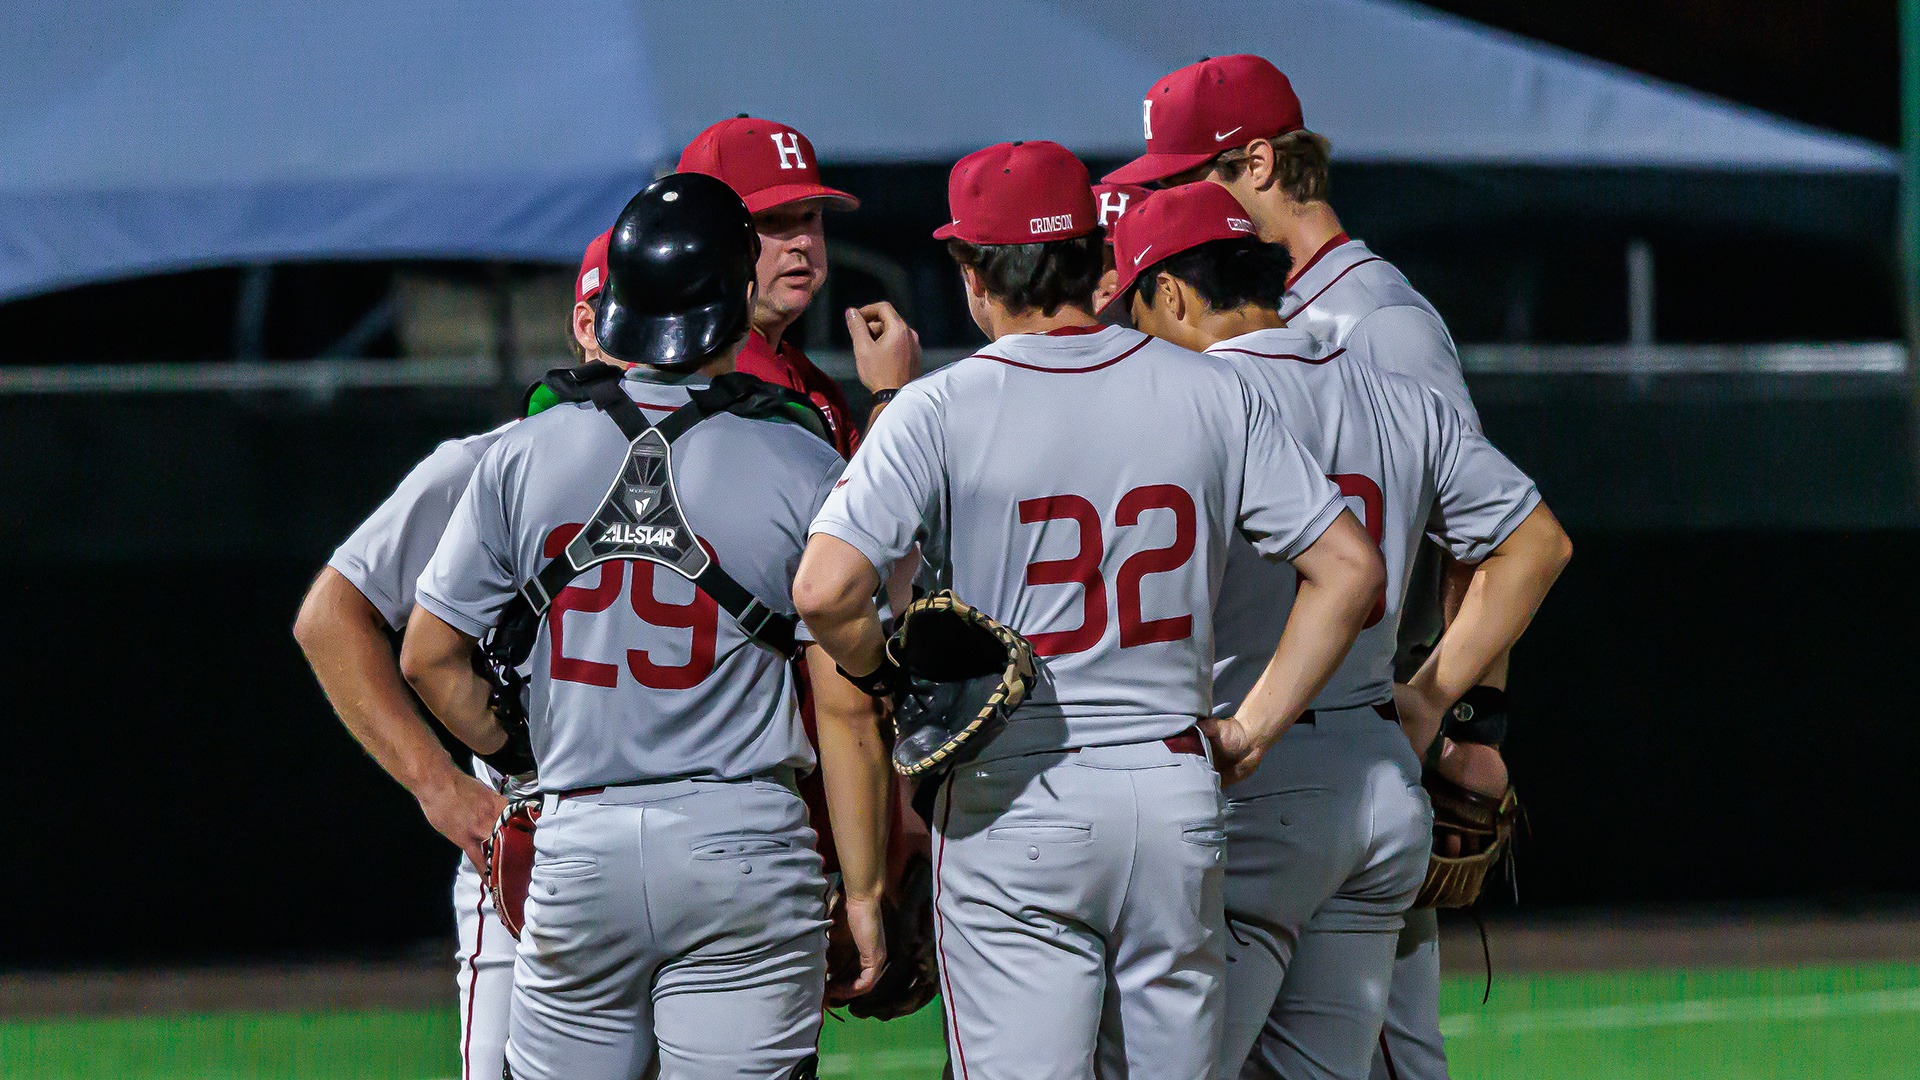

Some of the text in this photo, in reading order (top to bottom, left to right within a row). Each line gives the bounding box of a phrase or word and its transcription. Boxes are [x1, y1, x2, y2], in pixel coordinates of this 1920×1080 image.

[771, 132, 807, 169] H
[1030, 214, 1073, 234] CRIMSON
[1098, 192, 1130, 227] H
[600, 524, 675, 547] ALL-STAR
[1018, 483, 1197, 657] 32
[543, 522, 721, 690] 29
